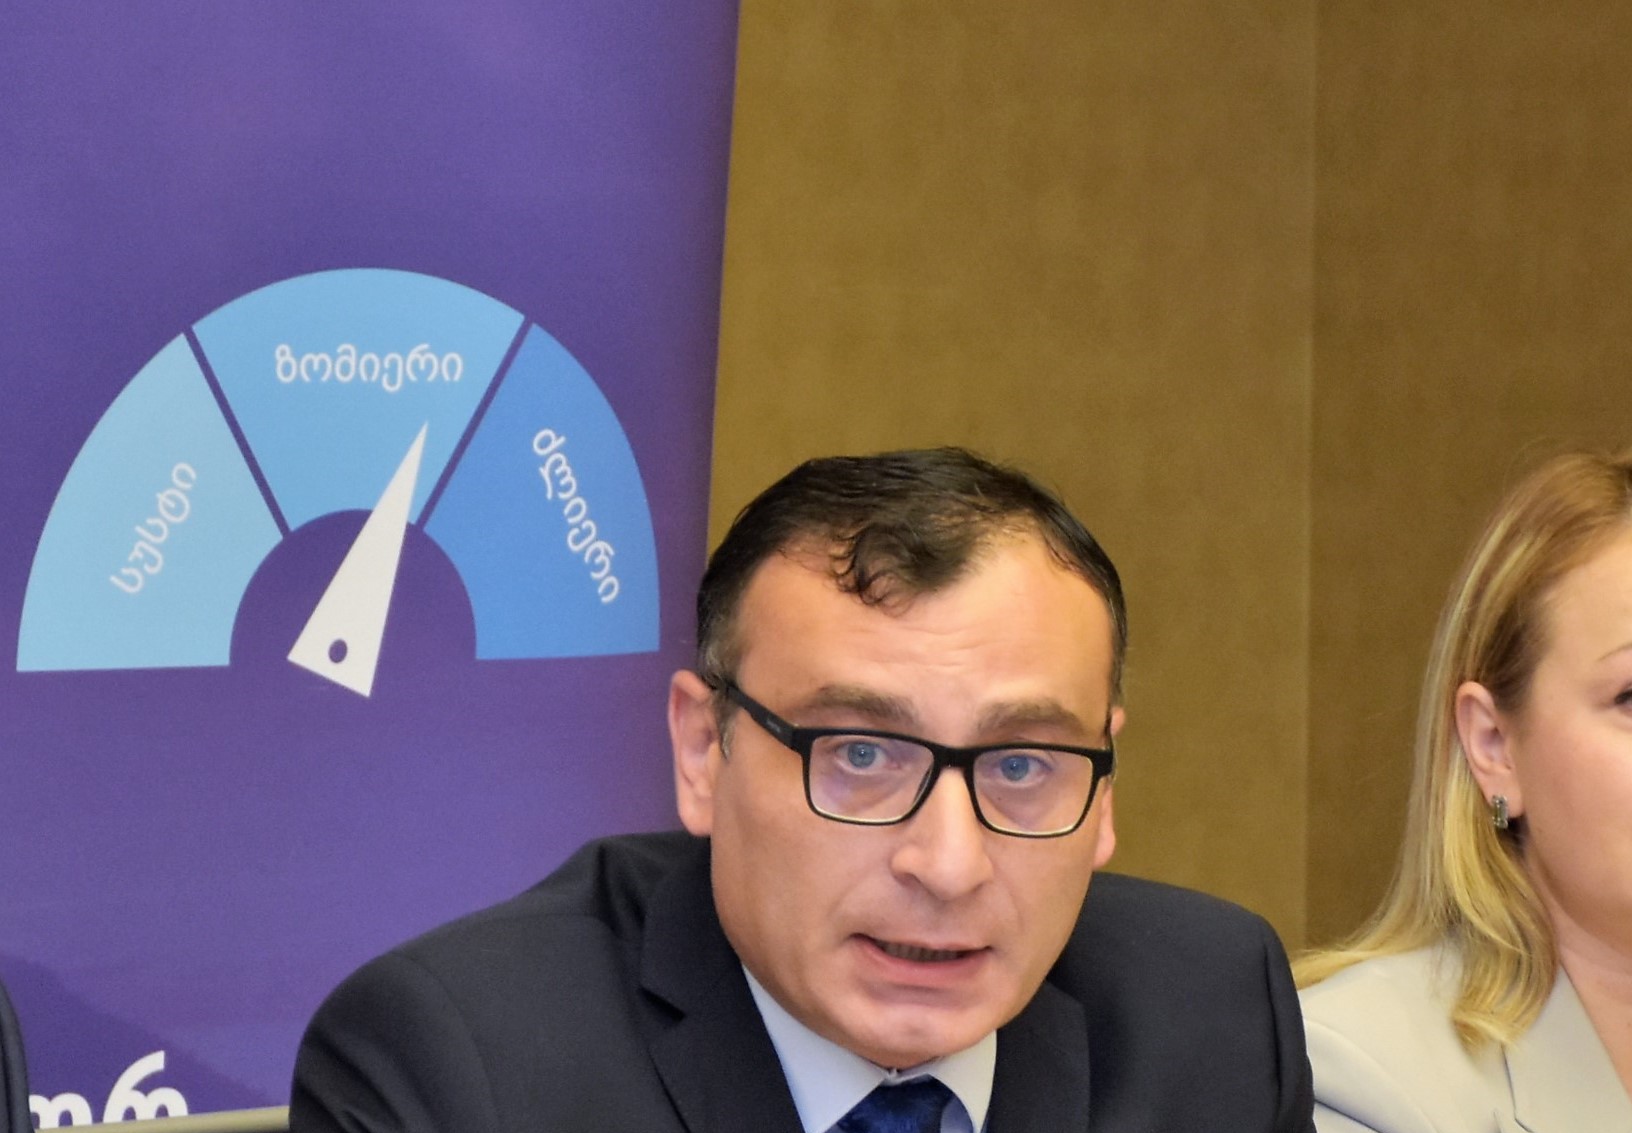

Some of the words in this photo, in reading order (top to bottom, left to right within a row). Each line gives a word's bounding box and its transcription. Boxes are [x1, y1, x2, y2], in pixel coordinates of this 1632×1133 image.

[273, 344, 464, 392] ზომიერი
[110, 461, 197, 596] სუსტი
[532, 428, 621, 604] ძლიერი
